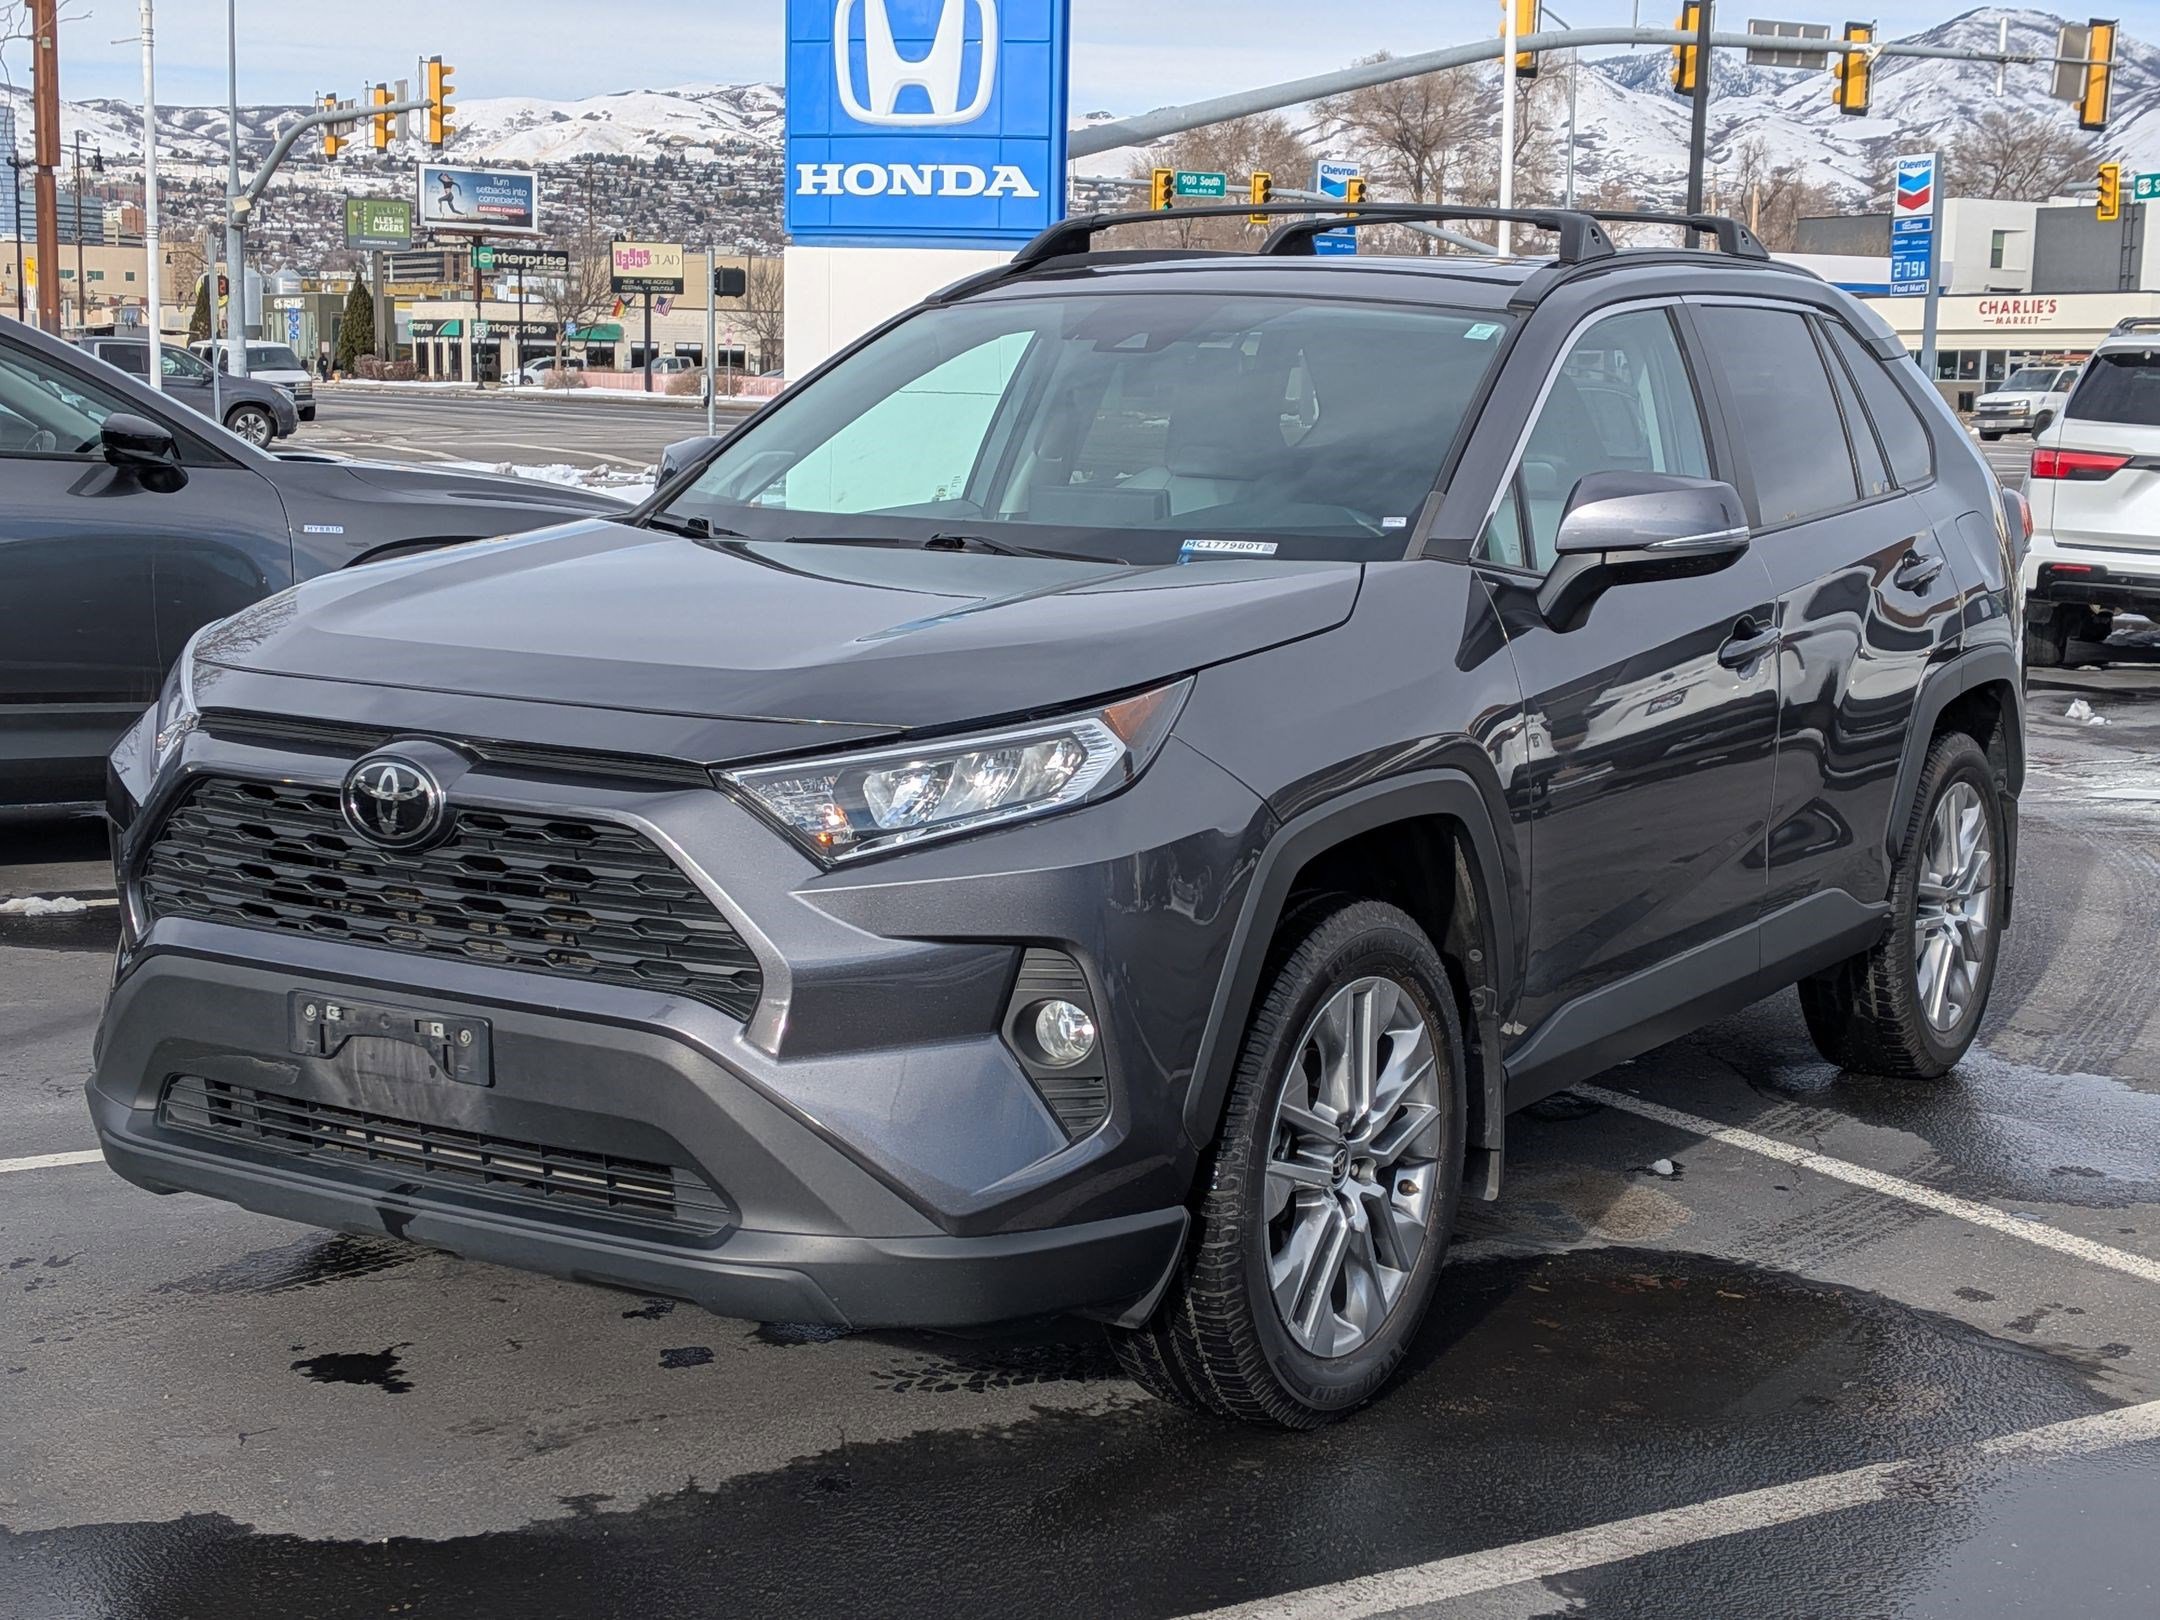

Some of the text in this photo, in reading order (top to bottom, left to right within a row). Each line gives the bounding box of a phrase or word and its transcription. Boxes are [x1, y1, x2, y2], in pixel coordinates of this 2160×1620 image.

[1321, 164, 1358, 176] Chevron
[492, 176, 510, 188] Turn
[796, 163, 1040, 198] HONDA
[1181, 175, 1221, 186] 900 South
[512, 188, 528, 198] into
[373, 216, 393, 224] ALES
[373, 221, 404, 232] LAGERS
[478, 252, 567, 267] enterprise
[1893, 284, 1925, 293] Food Mart
[1978, 299, 2057, 314] CHARLIE'S
[1995, 316, 2039, 324] MARKET
[305, 525, 343, 533] HYBRID
